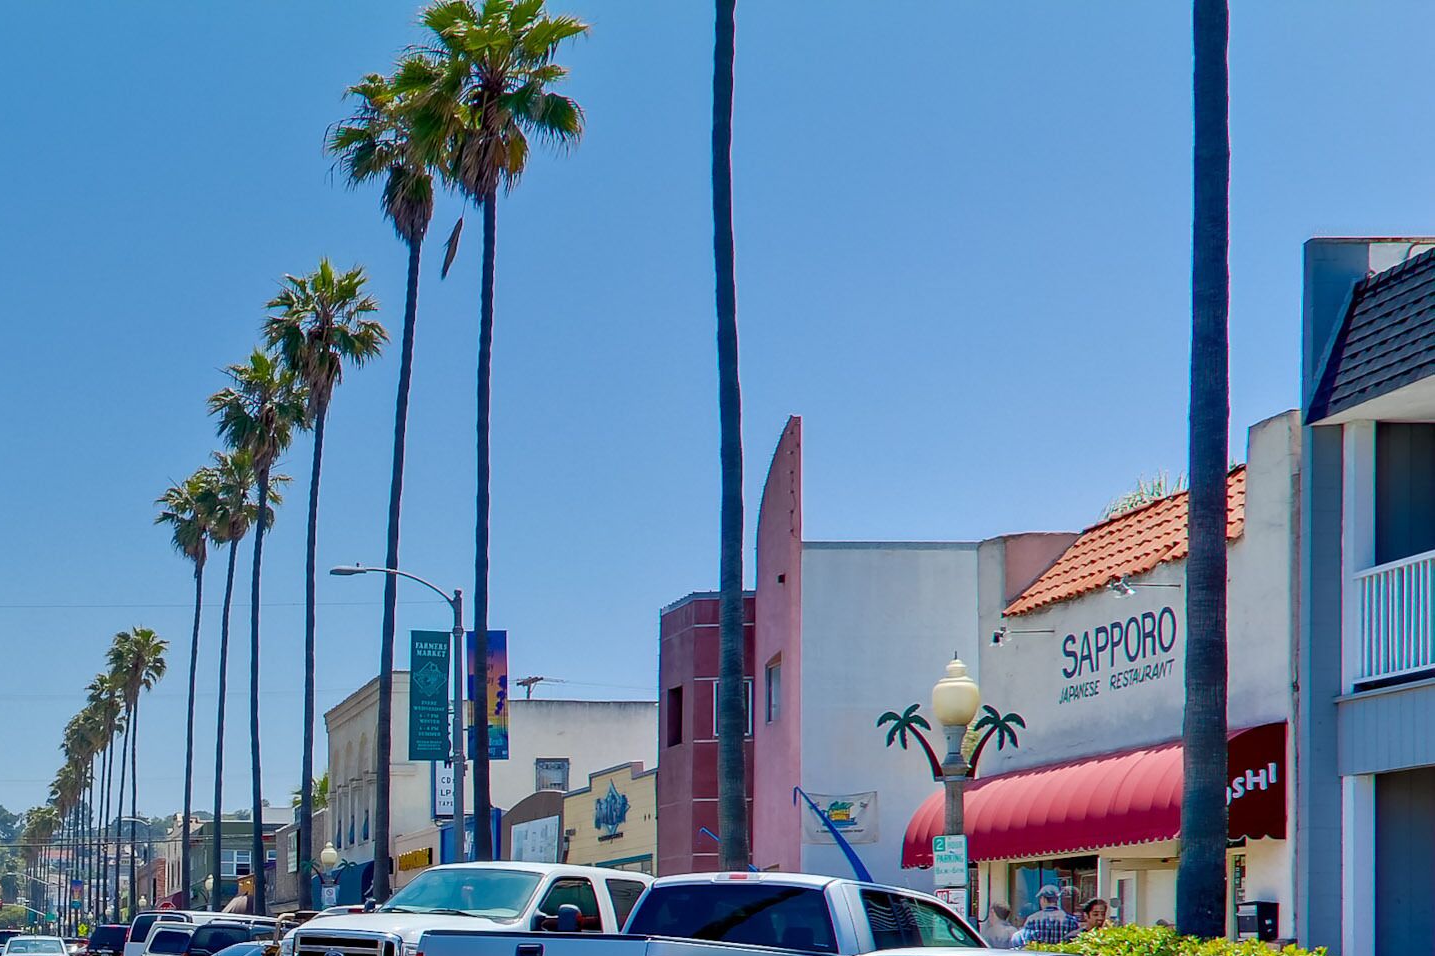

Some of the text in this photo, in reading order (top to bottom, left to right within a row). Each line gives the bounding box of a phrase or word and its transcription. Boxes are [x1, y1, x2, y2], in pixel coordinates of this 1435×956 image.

[415, 641, 447, 650] FARMERS
[1062, 606, 1176, 678] SAPPORO
[416, 649, 447, 658] MARKET
[1059, 658, 1175, 704] JAPANESE RESTAURANT
[935, 838, 944, 851] 2
[936, 854, 963, 862] PARKING
